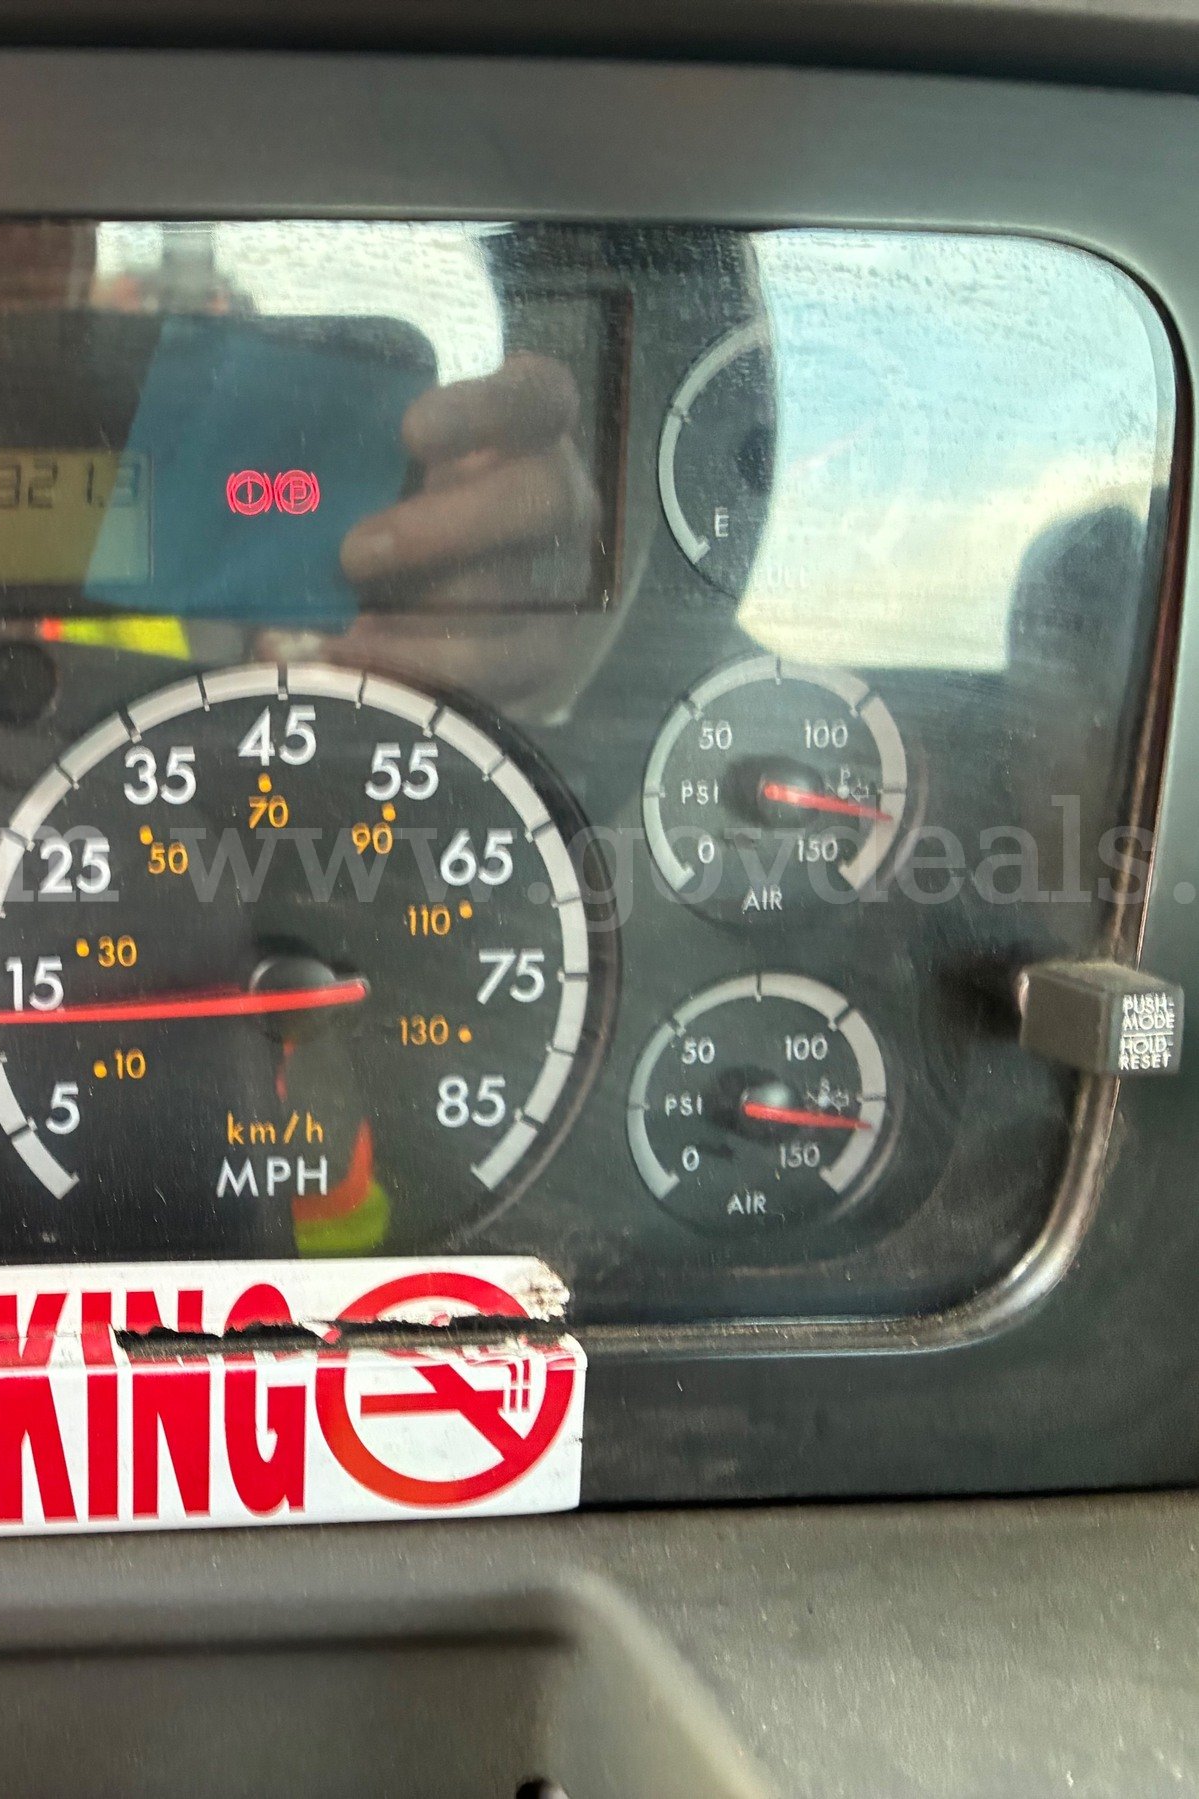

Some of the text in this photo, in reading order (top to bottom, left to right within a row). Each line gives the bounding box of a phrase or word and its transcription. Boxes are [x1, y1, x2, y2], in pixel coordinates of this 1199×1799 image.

[714, 507, 730, 538] E
[237, 705, 318, 767] 45
[699, 719, 733, 750] 50
[803, 719, 849, 748] 100
[122, 746, 197, 805] 35
[364, 742, 440, 801] 55
[681, 780, 720, 805] PSI
[248, 796, 289, 829] 70
[351, 822, 394, 856] 90
[698, 835, 714, 864] 0
[797, 833, 839, 863] 150
[40, 837, 112, 894] 25
[146, 842, 189, 875] 50
[438, 830, 516, 886] 65
[742, 886, 783, 911] AIR
[404, 904, 451, 936] 110
[97, 936, 138, 968] 30
[5, 955, 65, 1013] 15
[476, 948, 546, 1005] 75
[399, 1015, 449, 1047] 130
[1121, 1012, 1175, 1031] MODE
[114, 1047, 146, 1079] 10
[681, 1036, 715, 1064] 50
[784, 1034, 828, 1062] 100
[1118, 1051, 1171, 1070] RESET
[46, 1082, 81, 1133] 5
[435, 1076, 506, 1128] 85
[664, 1094, 703, 1117] PSI
[226, 1112, 325, 1146] km/h
[681, 1146, 700, 1172] 0
[779, 1142, 821, 1169] 150
[216, 1156, 329, 1198] MPH
[726, 1192, 767, 1215] AIR
